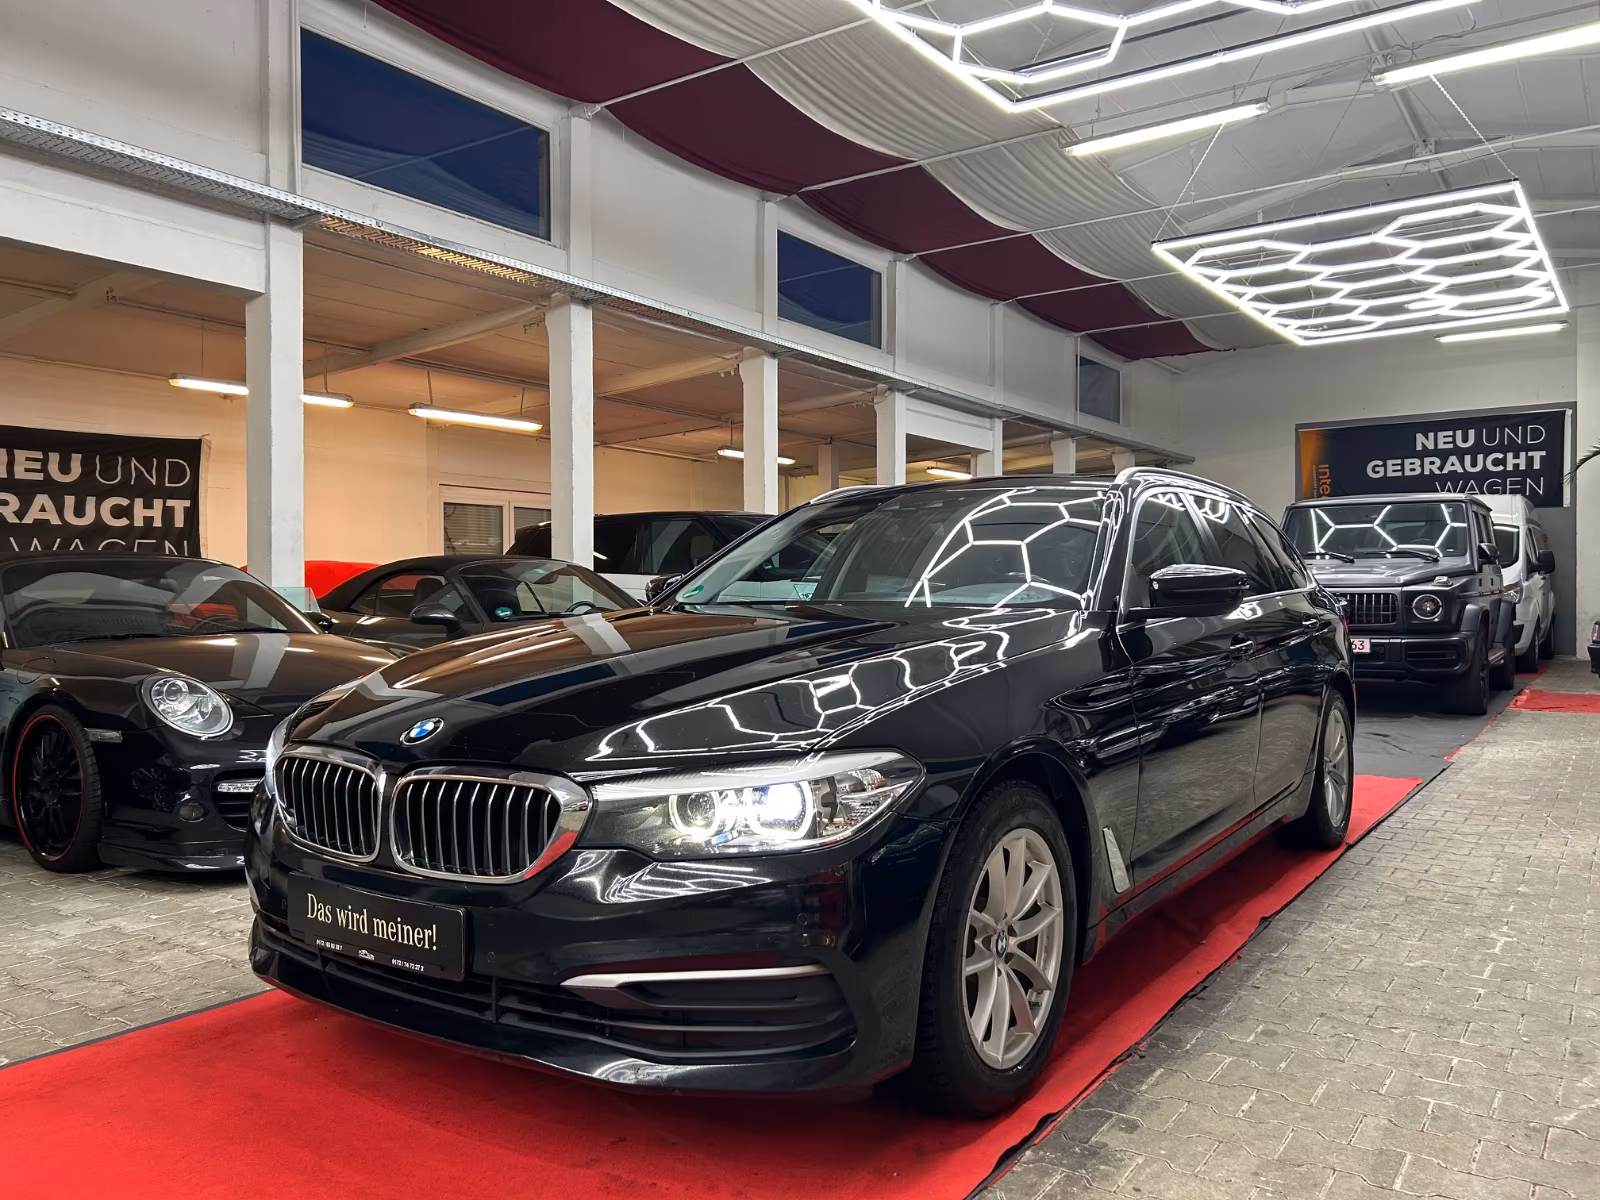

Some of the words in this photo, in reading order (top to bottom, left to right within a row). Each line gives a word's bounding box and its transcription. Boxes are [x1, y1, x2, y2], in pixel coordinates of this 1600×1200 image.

[1415, 429, 1475, 450] NEU
[1482, 425, 1546, 447] UND
[0, 448, 82, 483] EU
[95, 454, 191, 487] UND
[1366, 451, 1546, 479] GEBRAUCHT
[1435, 477, 1544, 496] WAGEN
[307, 893, 332, 923] Das
[336, 905, 368, 934] wird
[372, 916, 437, 951] meiner!
